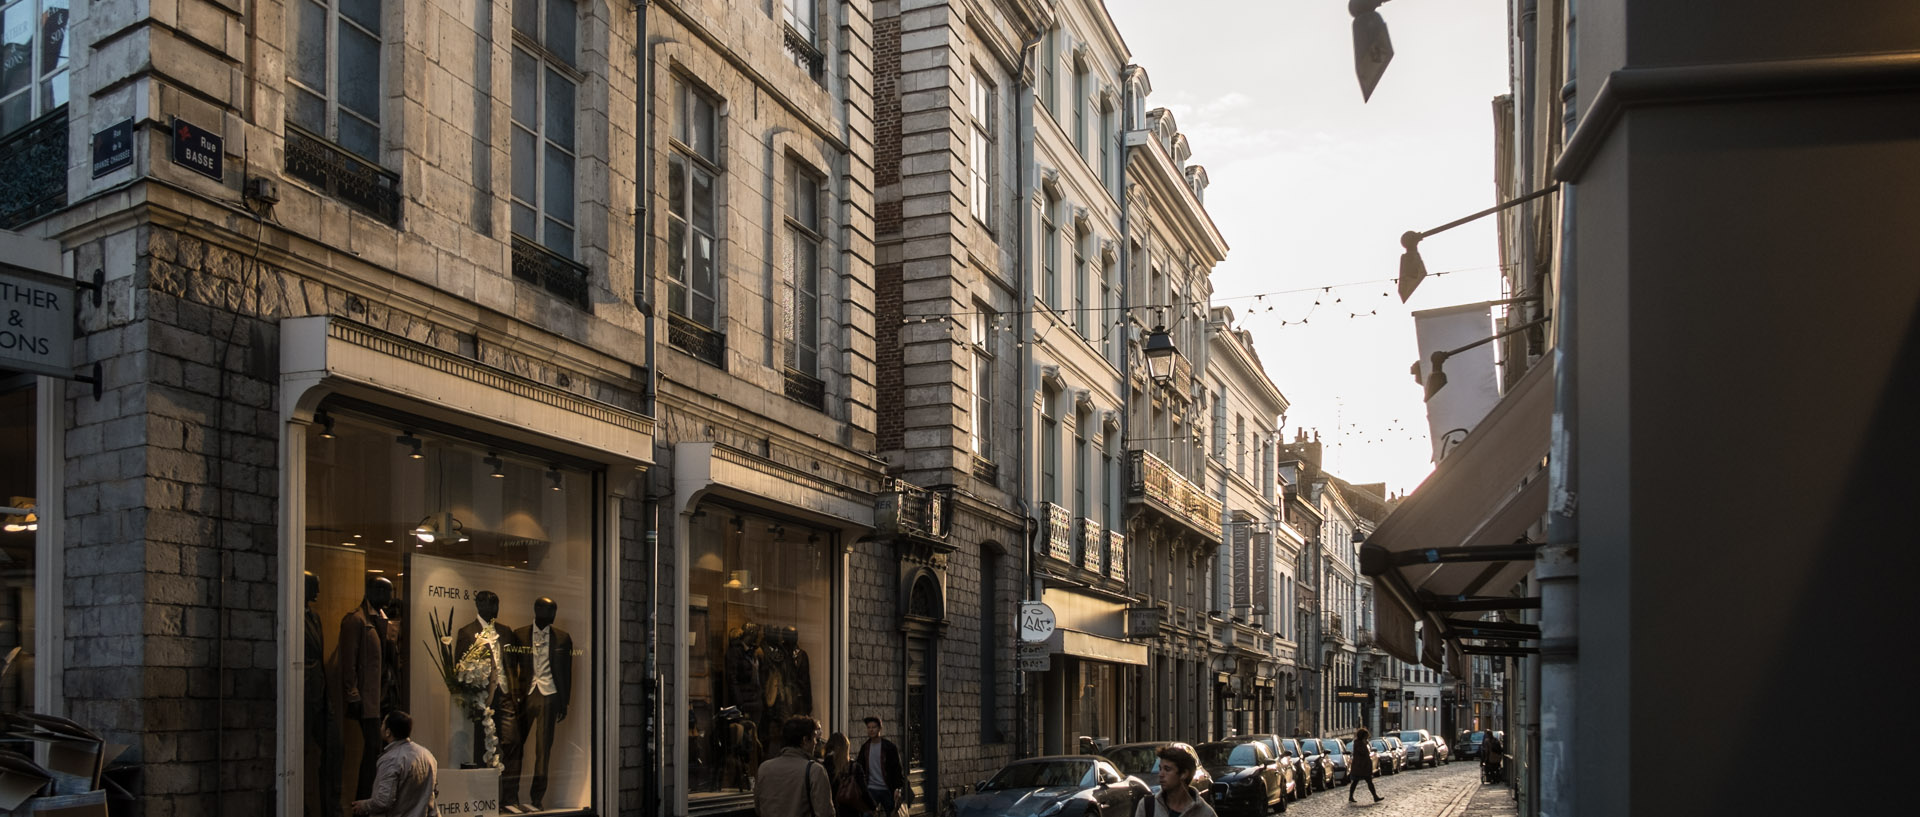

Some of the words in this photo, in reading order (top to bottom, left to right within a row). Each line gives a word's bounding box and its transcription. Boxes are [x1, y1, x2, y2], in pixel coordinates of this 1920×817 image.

[200, 136, 216, 152] Rue
[186, 148, 214, 169] BASSE
[8, 309, 24, 328] &
[428, 585, 461, 599] FATHER
[463, 589, 470, 600] &
[1256, 576, 1265, 595] Yves
[464, 802, 470, 813] &
[473, 800, 496, 811] SONS
